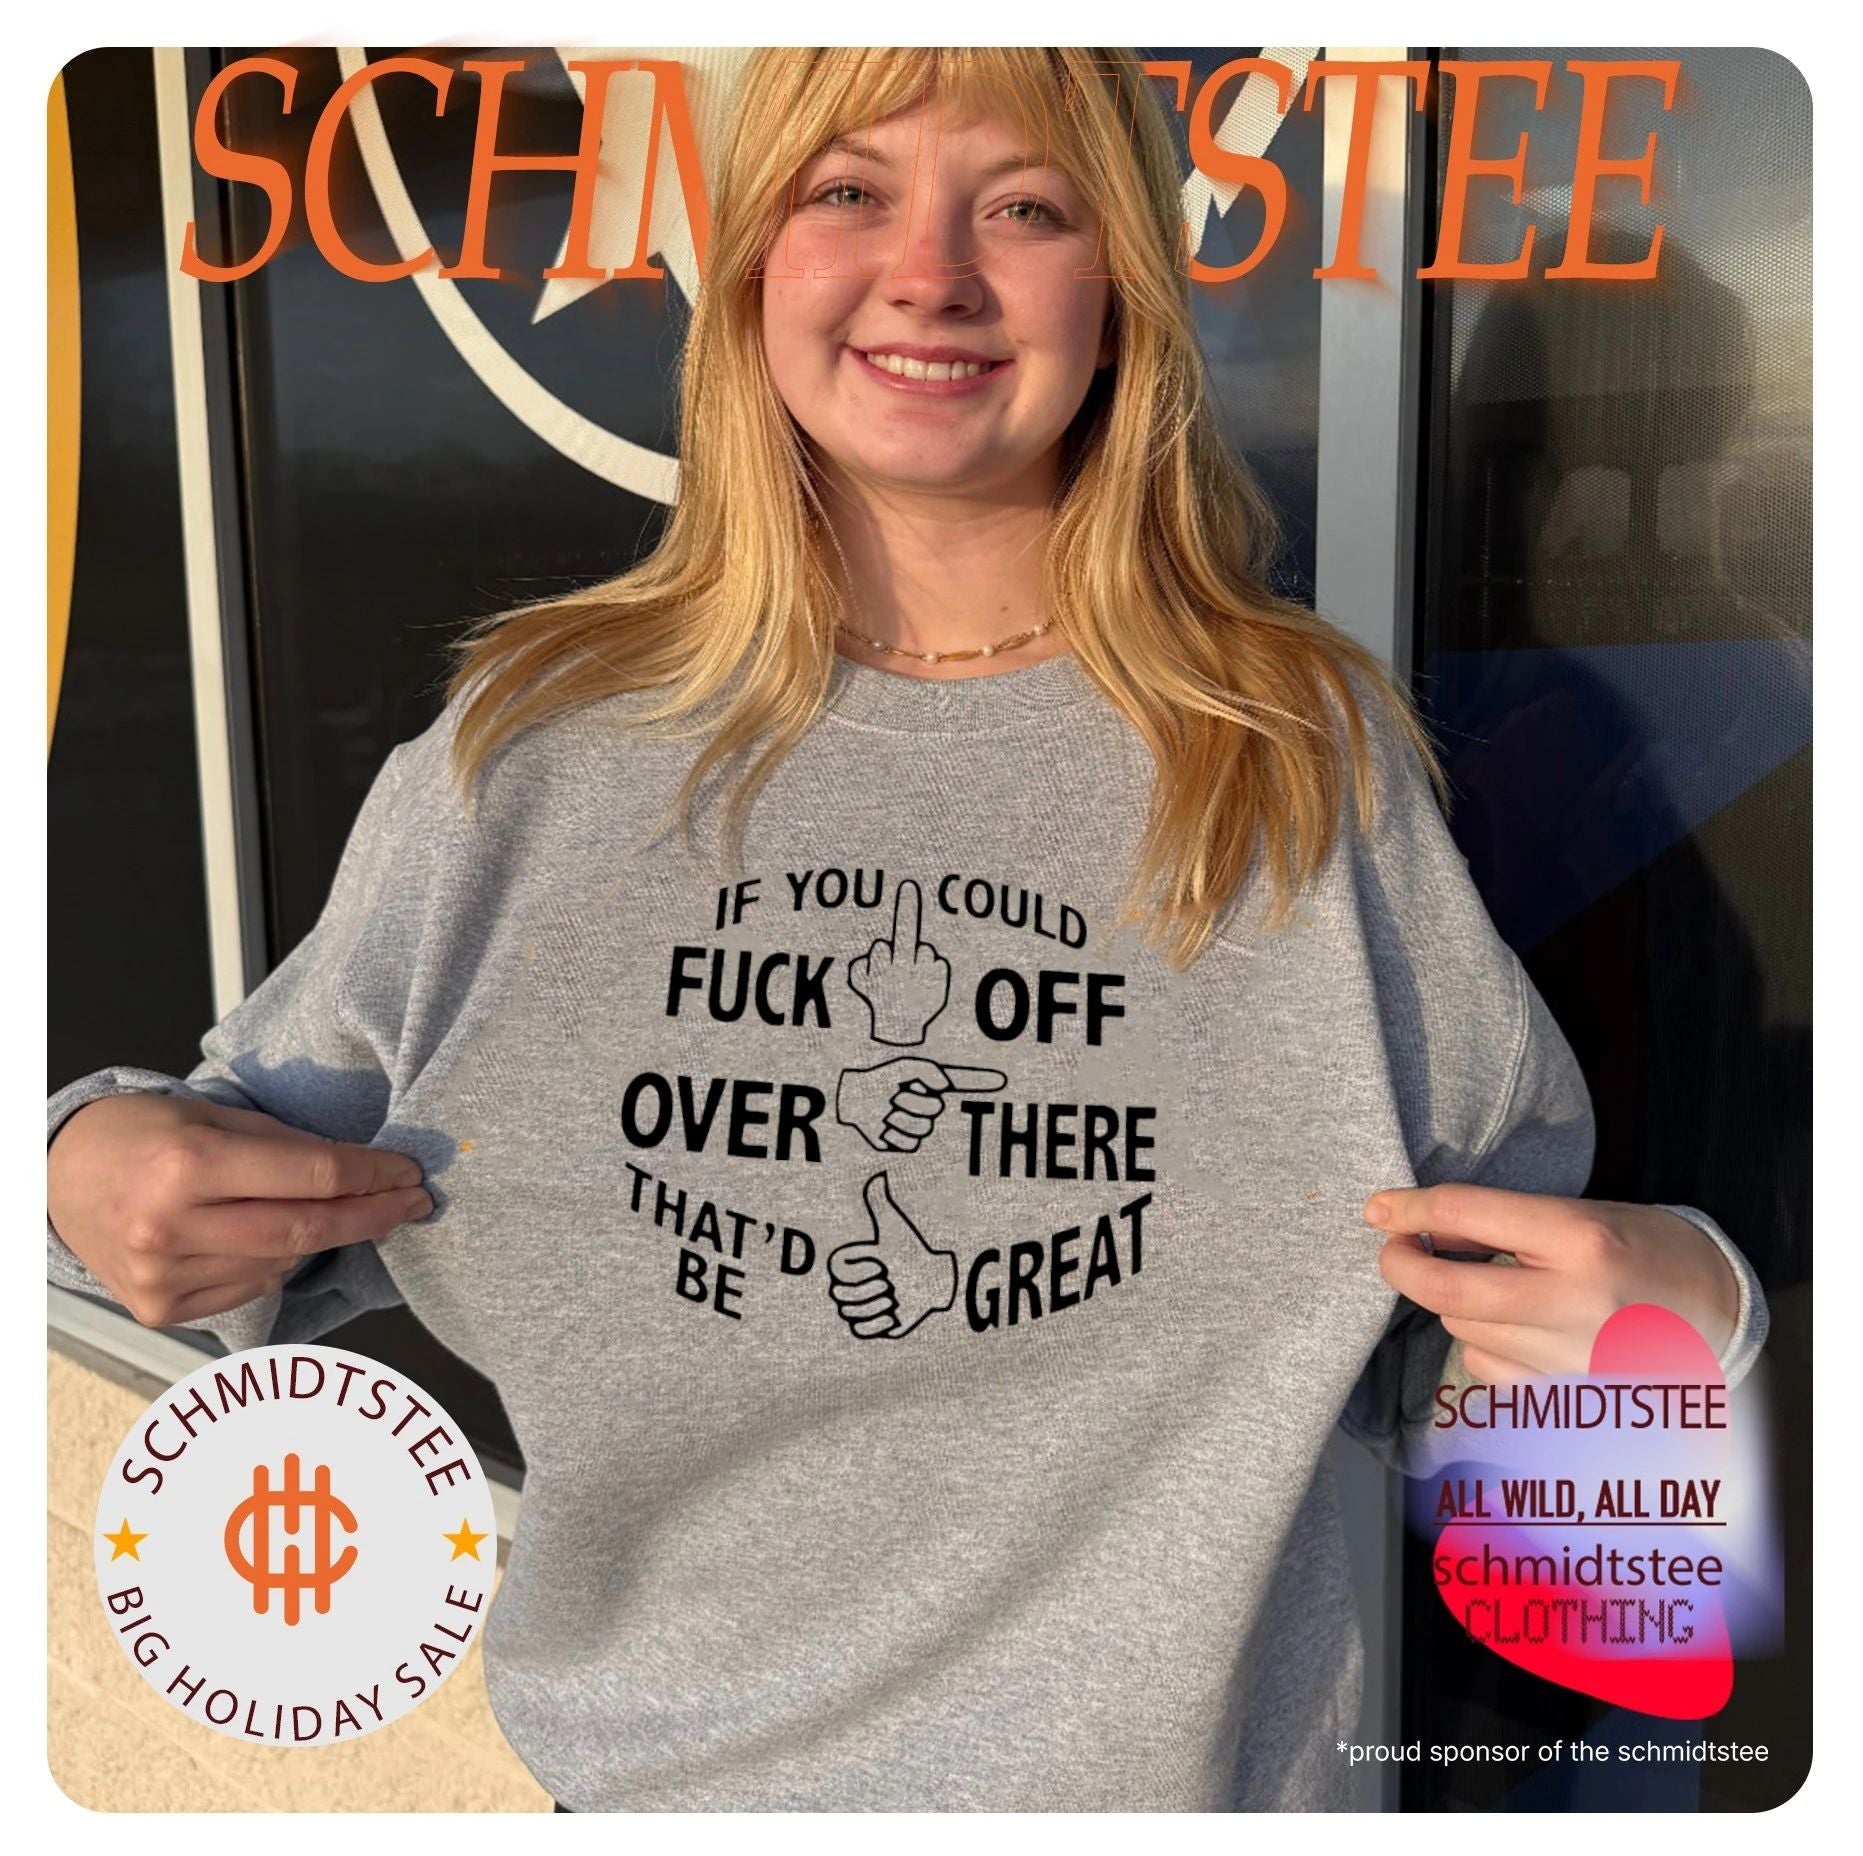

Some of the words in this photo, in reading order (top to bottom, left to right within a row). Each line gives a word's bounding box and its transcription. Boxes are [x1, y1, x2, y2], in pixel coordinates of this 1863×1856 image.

[716, 879, 761, 930] IF
[787, 869, 883, 911] YOU
[938, 874, 1087, 949] COULD
[666, 946, 835, 1028] FUCK
[975, 968, 1125, 1046] OFF
[622, 1072, 826, 1163] OVER
[961, 1101, 1156, 1181] THERE
[675, 1247, 745, 1320] BE
[966, 1193, 1152, 1332] GREAT
